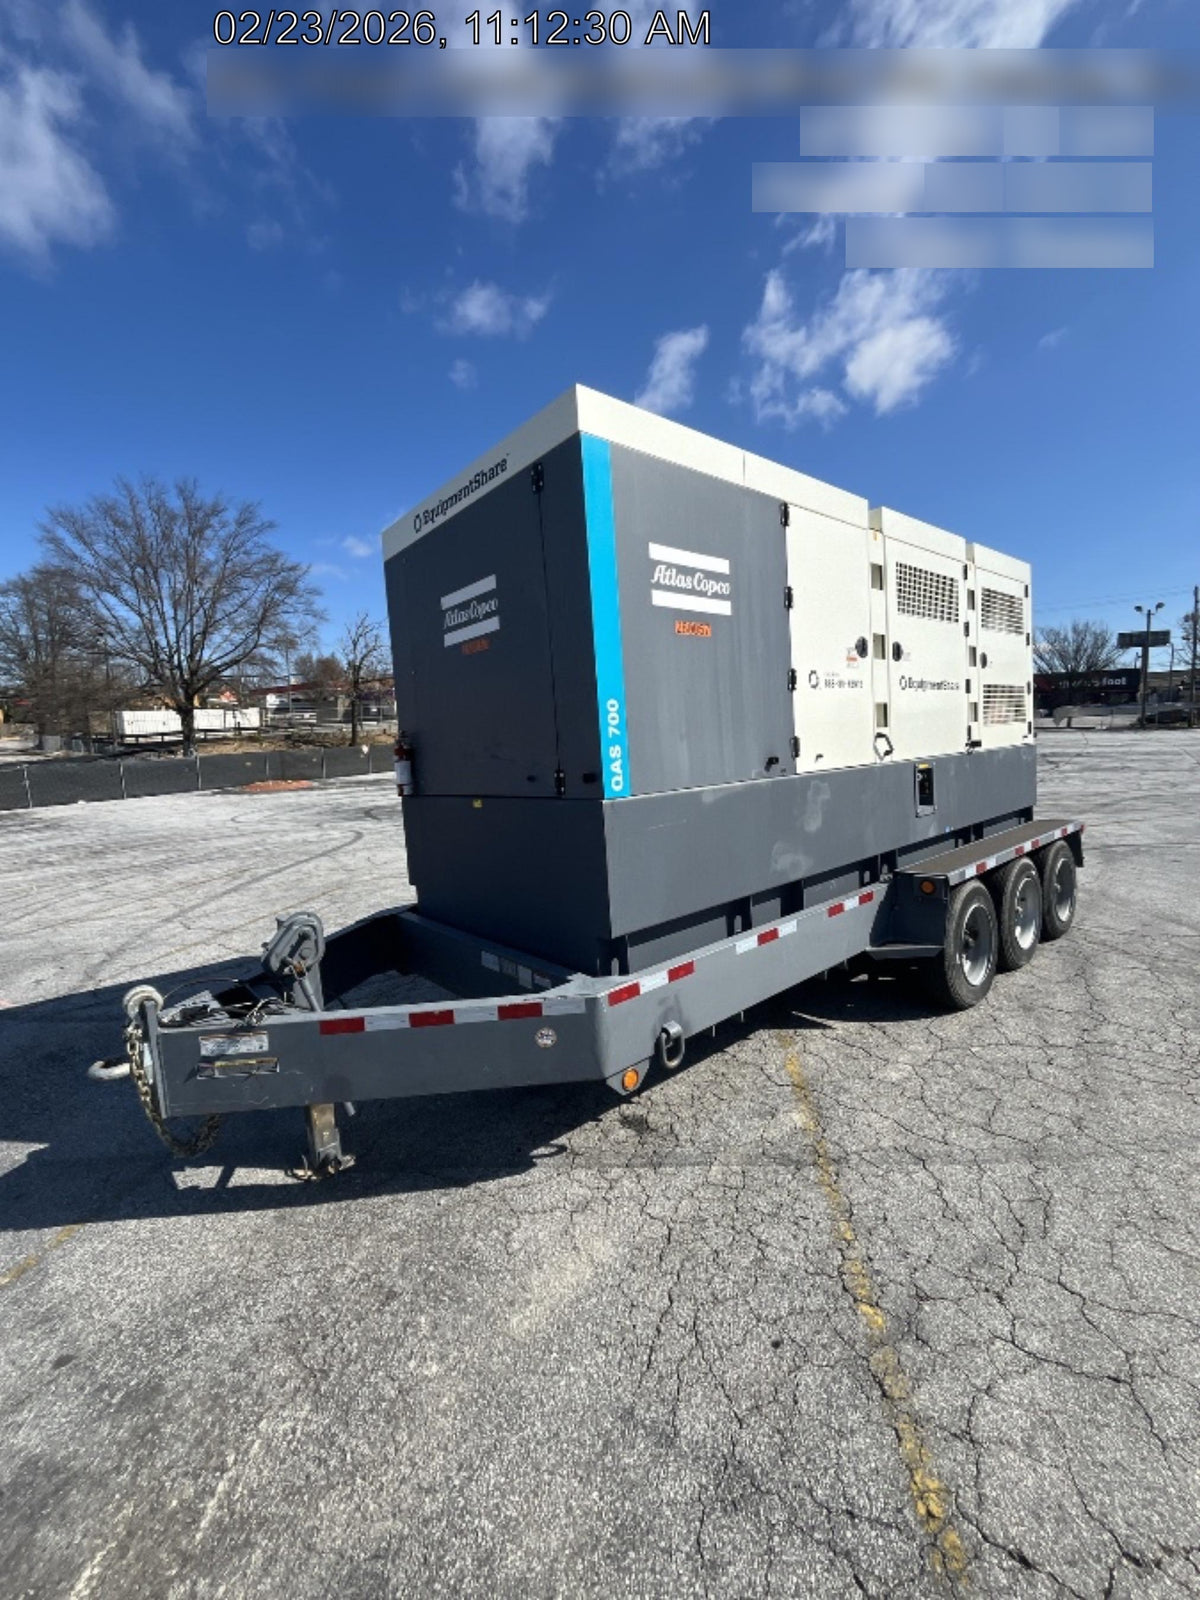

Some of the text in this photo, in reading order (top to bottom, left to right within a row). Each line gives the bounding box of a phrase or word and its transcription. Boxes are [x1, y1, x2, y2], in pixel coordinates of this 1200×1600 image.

[422, 458, 508, 525] EquipmentShare
[651, 564, 731, 597] Atlas Copco
[443, 598, 499, 630] Atlas Copco
[606, 698, 624, 792] QAS 700
